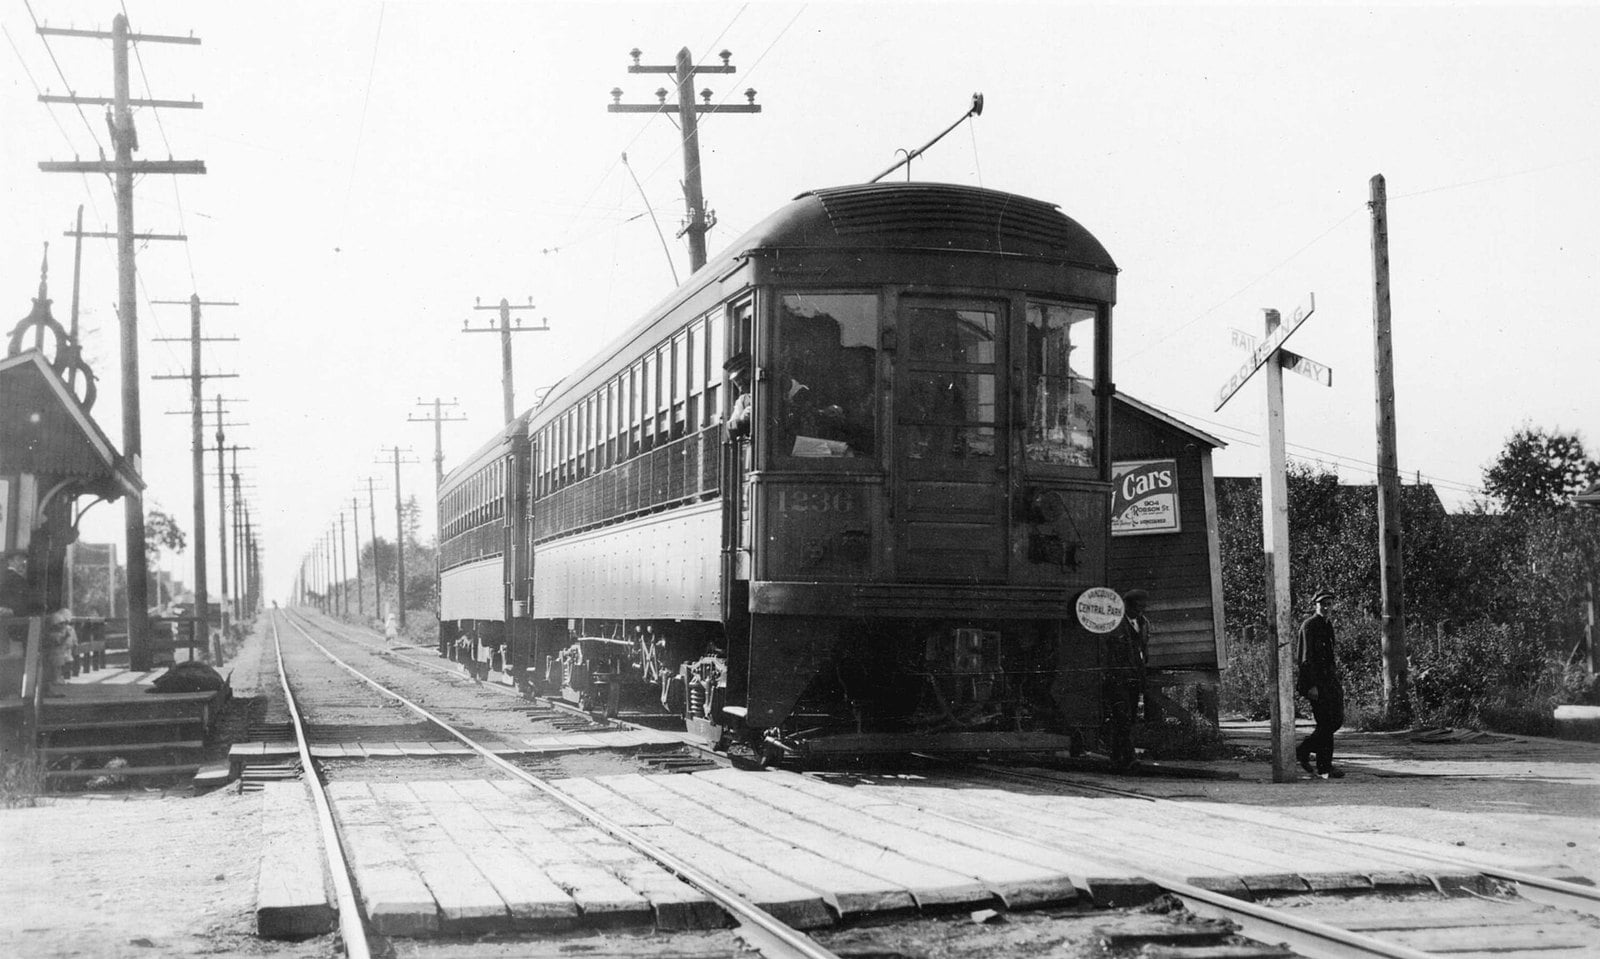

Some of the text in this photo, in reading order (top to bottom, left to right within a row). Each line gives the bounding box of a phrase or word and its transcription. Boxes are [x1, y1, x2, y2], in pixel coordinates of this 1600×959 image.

[1219, 305, 1303, 401] CROSSING
[1122, 470, 1172, 500] Cars
[777, 490, 853, 513] 1236
[1079, 602, 1122, 617] CENTRAL PARK
